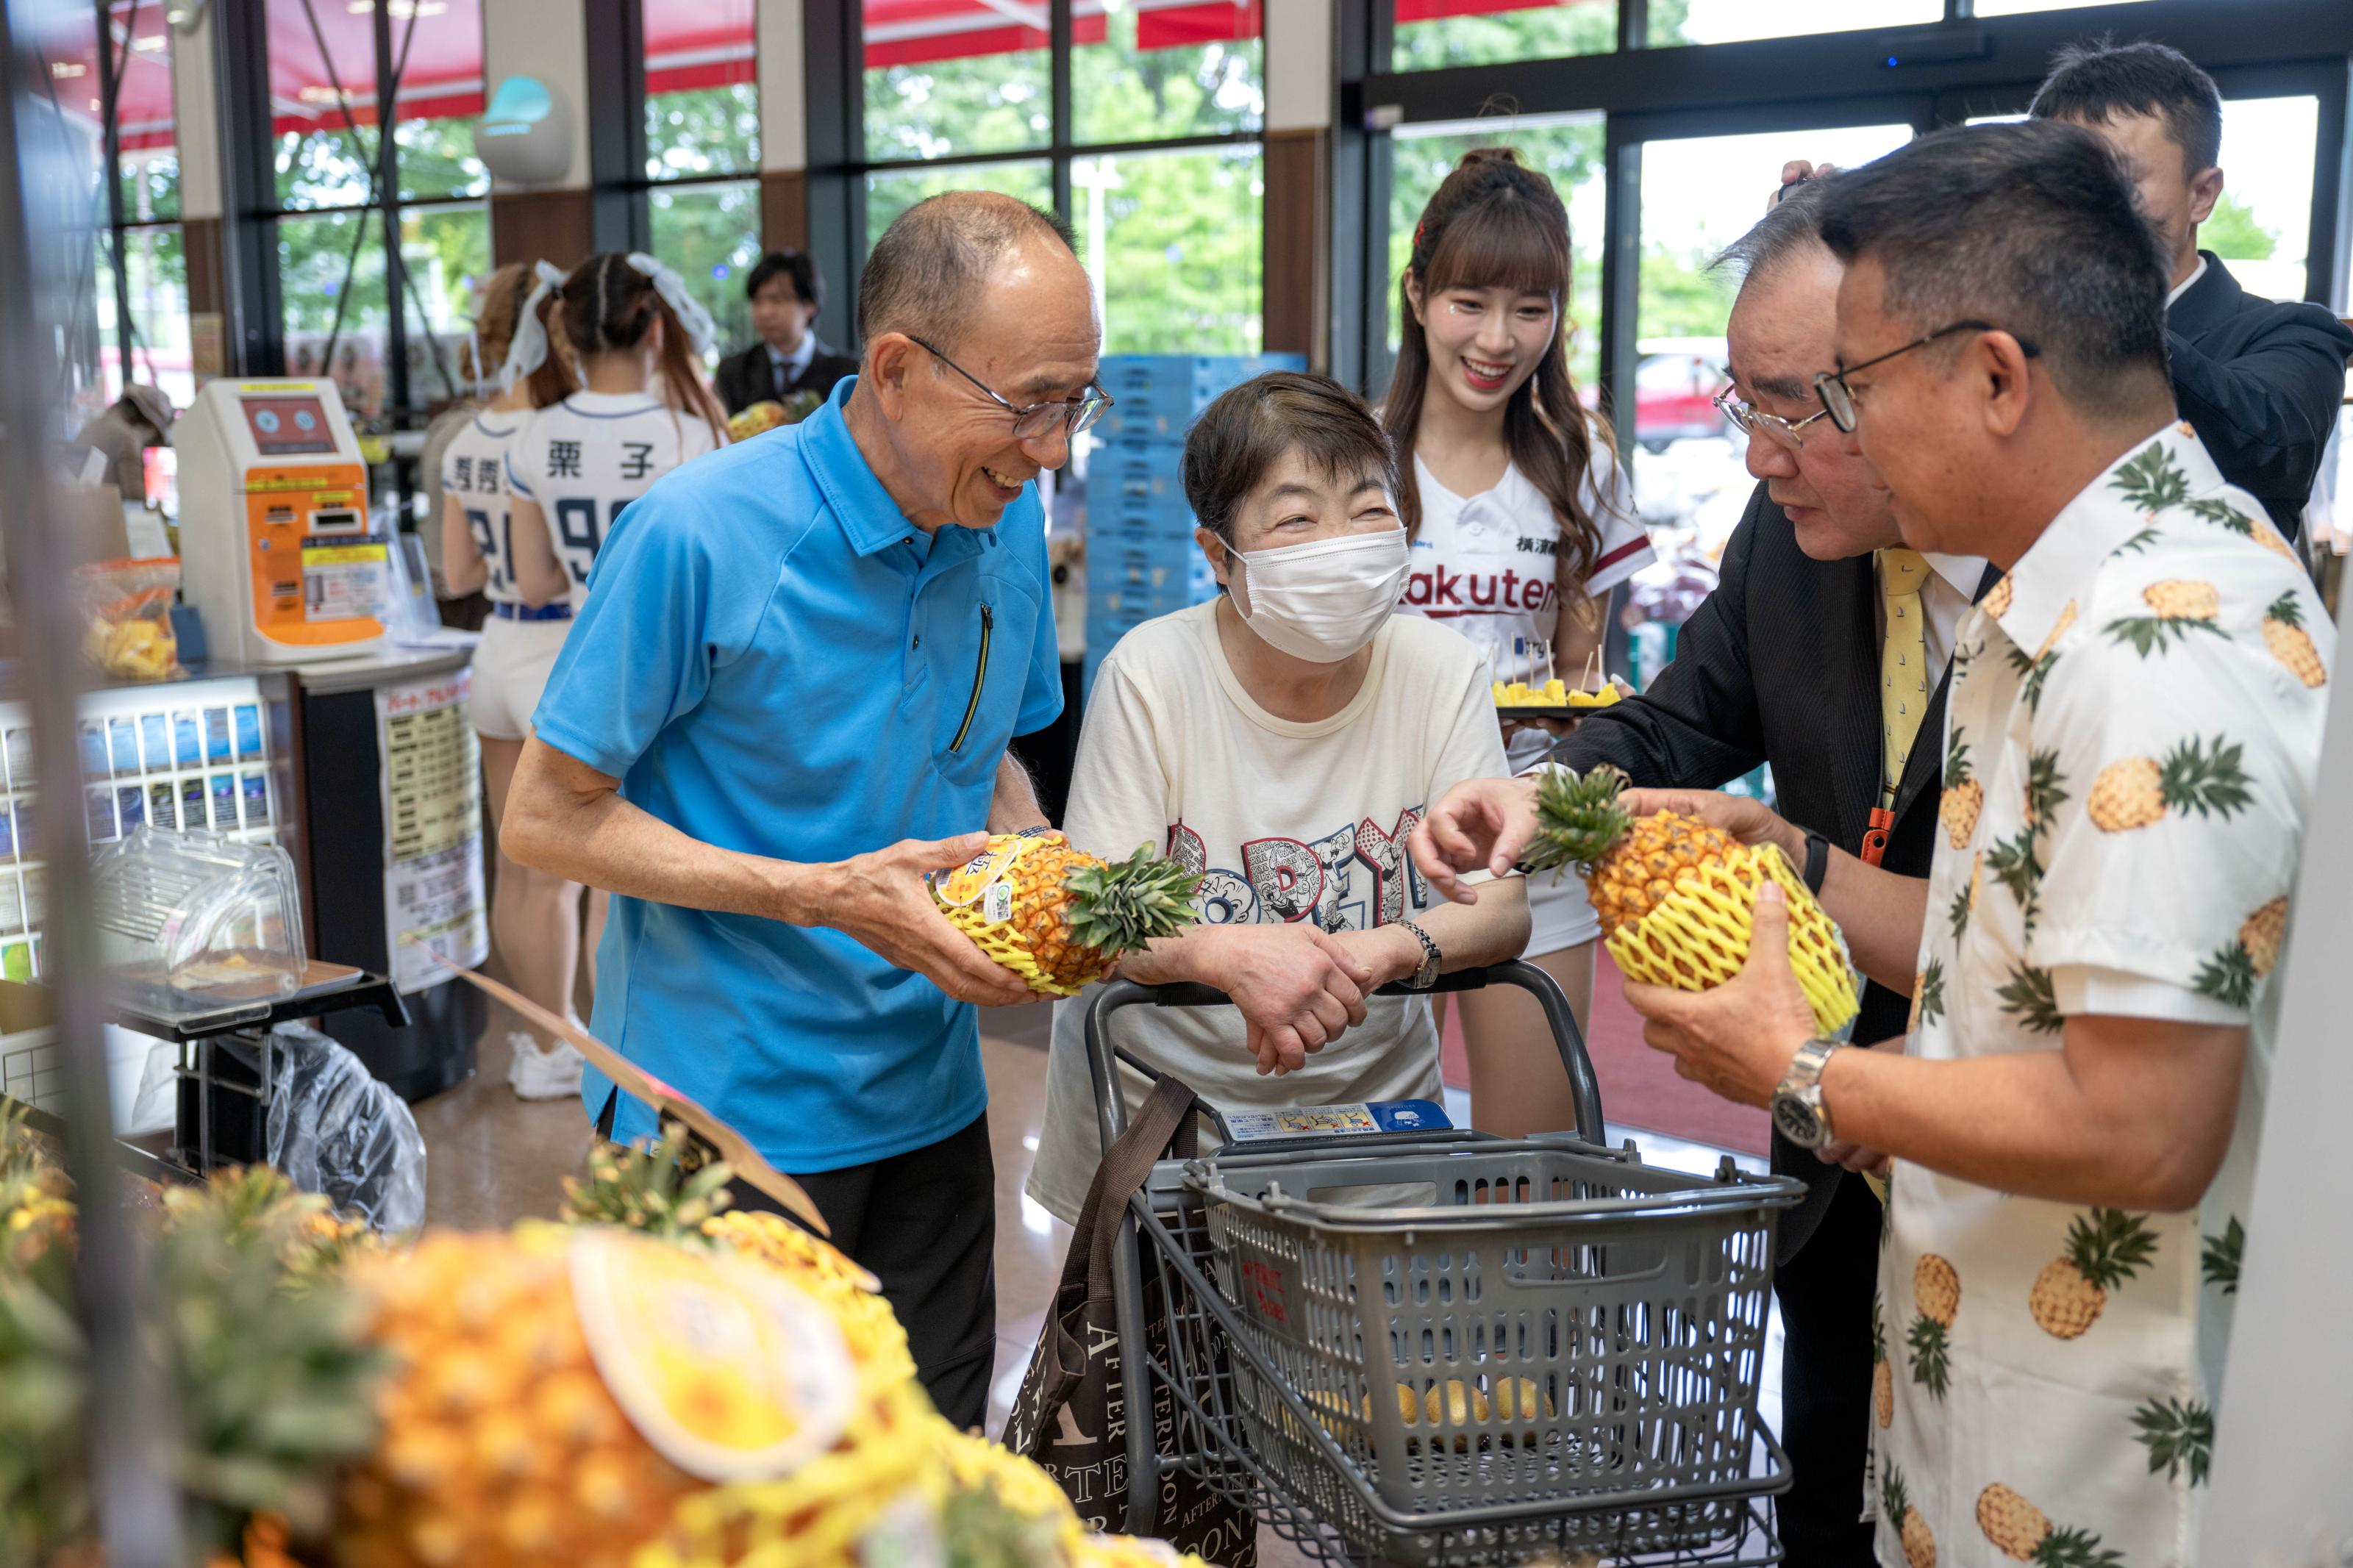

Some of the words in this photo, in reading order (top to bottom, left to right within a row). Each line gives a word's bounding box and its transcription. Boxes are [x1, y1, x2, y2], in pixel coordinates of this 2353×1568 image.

[548, 441, 654, 479] 栗子
[556, 498, 638, 586] 9
[1398, 564, 1557, 612] akute
[1167, 804, 1428, 930] POPEY
[1182, 1492, 1223, 1528] AFTER
